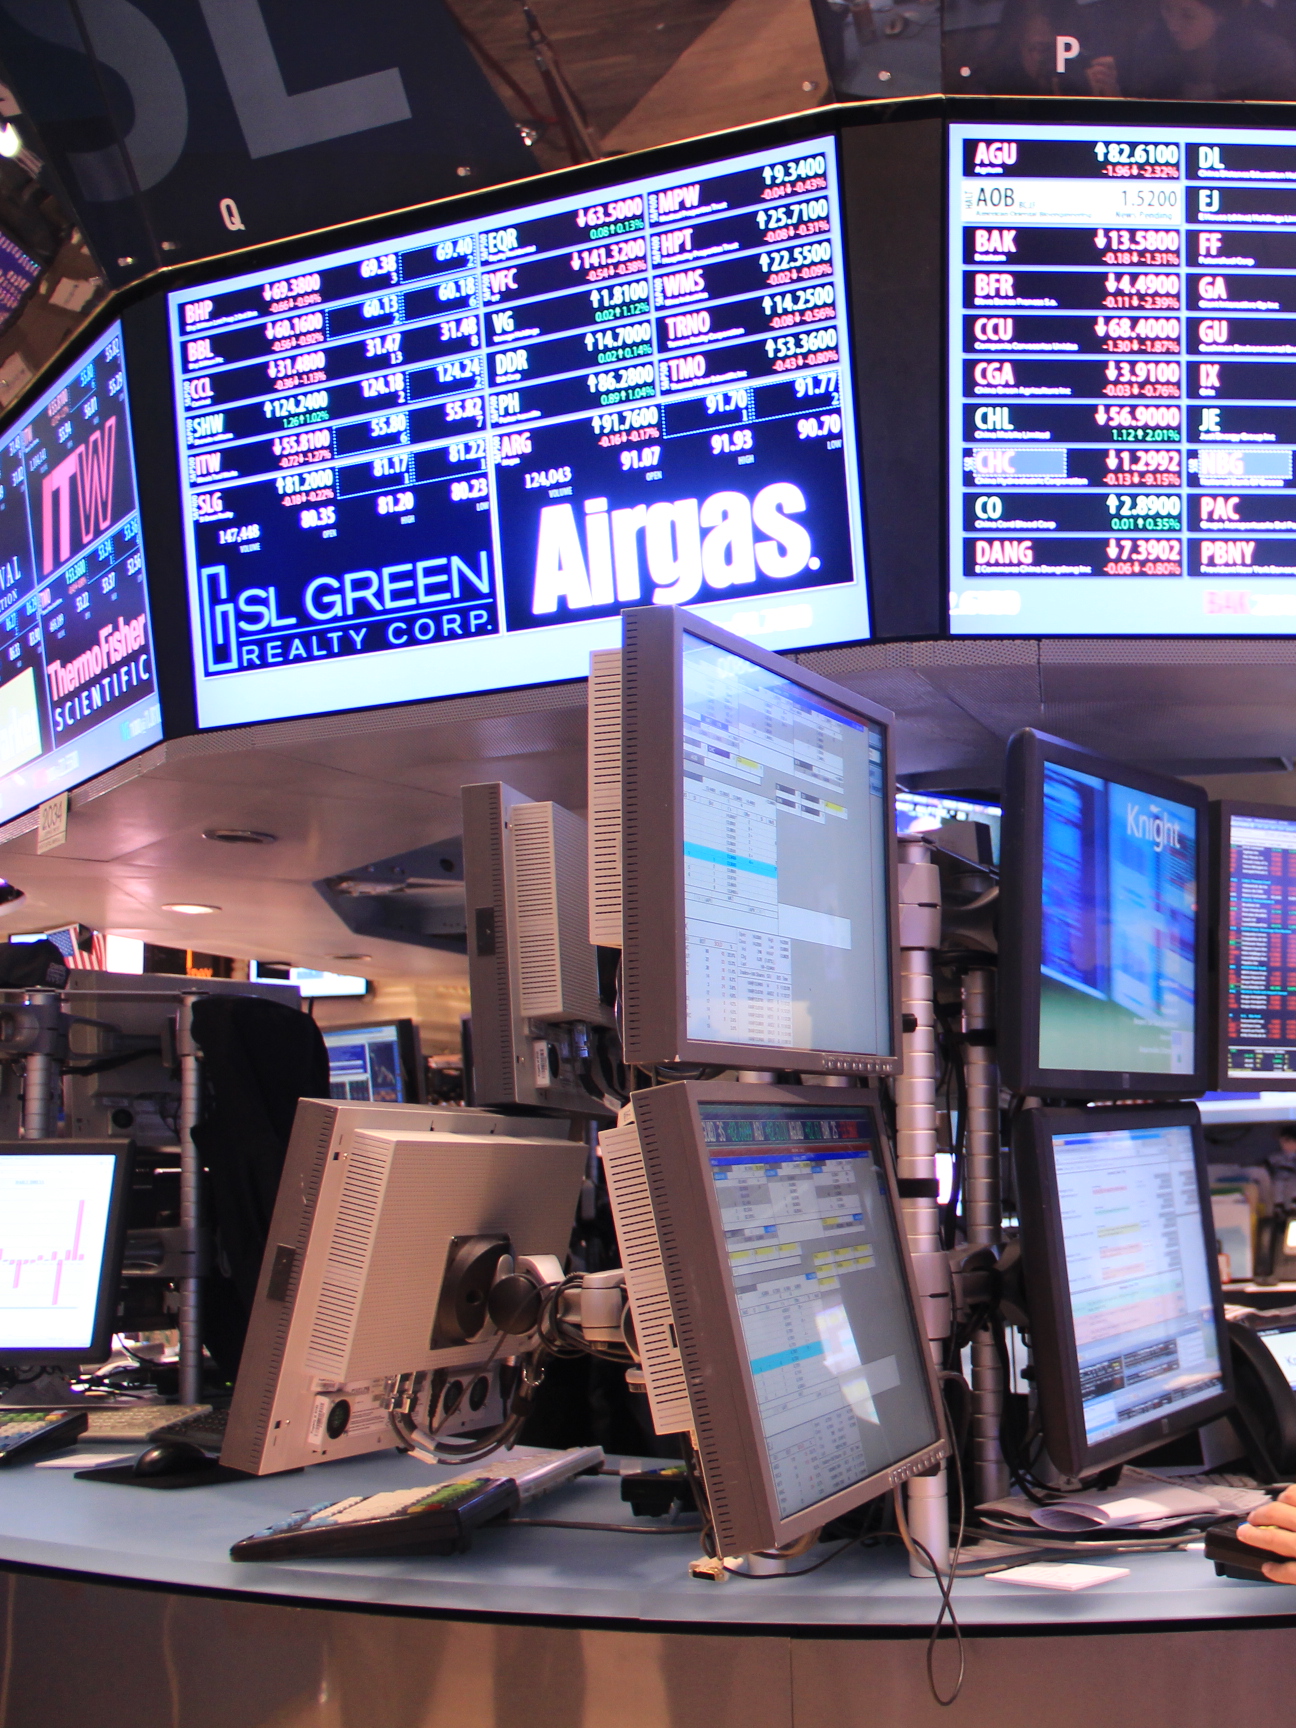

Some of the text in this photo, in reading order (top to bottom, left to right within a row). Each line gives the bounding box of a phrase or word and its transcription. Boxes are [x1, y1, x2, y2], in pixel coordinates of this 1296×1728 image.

[1055, 35, 1080, 72] P
[974, 142, 1179, 165] AGU 82.6100
[1199, 146, 1224, 168] DL
[658, 156, 826, 212] MPW 9.3400
[976, 187, 1178, 207] AOB 1.5200
[1199, 189, 1220, 212] EJ
[219, 198, 245, 231] Q
[488, 197, 642, 253] EQR 63.5000
[661, 200, 828, 254] HPT 25.7100
[974, 230, 1179, 252] BAK 13.5800
[1199, 233, 1222, 255] FF
[490, 239, 646, 293] VFC 141.3200
[663, 242, 831, 297] WMS 22.5500
[974, 274, 1179, 296] BFR 4.4900
[1199, 276, 1227, 299] GA
[184, 300, 213, 324] BHP
[492, 281, 648, 334] VG 1.8100
[665, 286, 834, 339] TRNO 14.2500
[187, 312, 323, 361] BBL 60.1600
[495, 322, 651, 373] DDR 14.7000
[974, 318, 1179, 340] CCU 68.4000
[1199, 321, 1228, 342] GU
[669, 329, 837, 380] TMO 53.3600
[190, 351, 325, 399] CCL 31.4800
[499, 365, 654, 415] PH 86.2800
[974, 362, 1180, 385] CGA 3.9100
[1199, 364, 1220, 387] IX
[193, 391, 329, 436] SHW 124.2400
[501, 407, 659, 457] ARG 91.7600
[974, 407, 1180, 430] CHL 56.9000
[1199, 408, 1220, 430] JE
[196, 429, 330, 475] ITW 55.8100
[525, 447, 661, 489] 124,043 91.07
[1121, 451, 1180, 471] 1.2992
[42, 415, 116, 575] ITW
[198, 469, 333, 514] SLG 81.2000
[974, 496, 1180, 519] CO 2.8900
[1200, 496, 1240, 520] PAC
[301, 506, 335, 528] 80.35
[532, 482, 821, 615] Airgas.
[974, 540, 1180, 563] DANG 7.3902
[1200, 541, 1256, 564] PBNY
[238, 551, 490, 631] SL GREEN
[242, 610, 492, 667] REALTY CORP.
[55, 653, 150, 731] SCIENTIFIC
[42, 800, 63, 831] 2034
[1127, 803, 1181, 852] Knight
